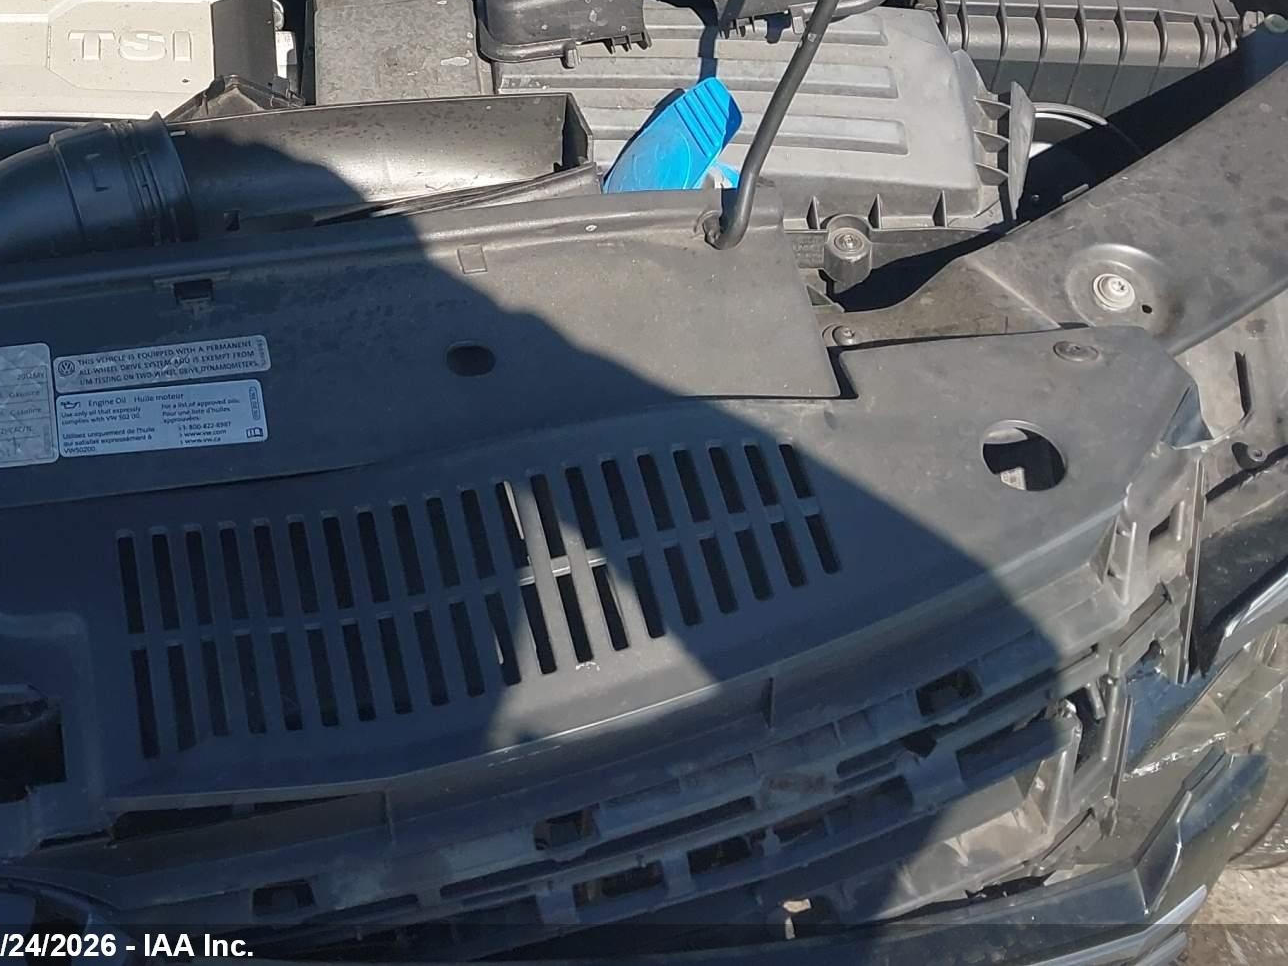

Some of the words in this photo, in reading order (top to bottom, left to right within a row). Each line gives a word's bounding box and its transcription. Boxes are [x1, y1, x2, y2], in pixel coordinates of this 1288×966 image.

[68, 29, 193, 62] TSI
[77, 357, 94, 366] THIS
[95, 355, 125, 363] VEHICLE
[136, 349, 174, 358] EQUIPPED
[175, 346, 196, 355] WITH
[205, 340, 252, 350] PERMANENT
[119, 362, 141, 371] DRIVE
[143, 359, 171, 368] SYSTEM
[200, 352, 231, 361] EXEMPT
[231, 349, 254, 358] FROM
[93, 375, 122, 384] TESTING
[122, 372, 134, 381] ON
[87, 398, 114, 406] Engine
[114, 396, 126, 405] Oil
[133, 394, 154, 403] Huile
[154, 392, 184, 400] moteur
